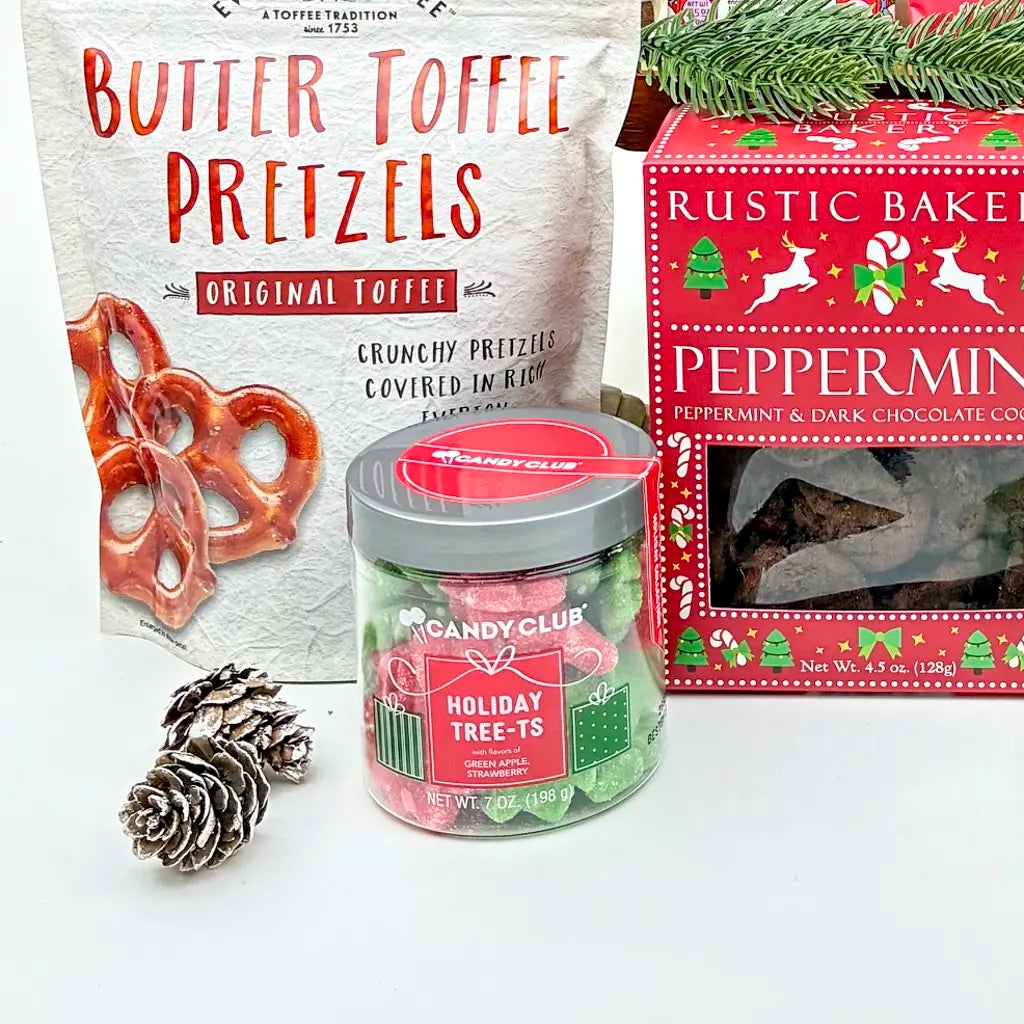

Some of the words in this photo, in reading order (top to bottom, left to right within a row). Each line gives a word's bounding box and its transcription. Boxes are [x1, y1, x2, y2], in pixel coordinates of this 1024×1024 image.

[263, 10, 269, 20] A
[274, 10, 321, 20] TOFFEE
[325, 10, 398, 20] TRADITION
[329, 23, 358, 33] 1753
[84, 47, 326, 138] BUTTER
[369, 49, 570, 145] TOFFEE
[167, 151, 482, 245] PRETZELS
[668, 190, 860, 222] RUSTIC
[206, 279, 336, 307] ORIGINAL
[356, 277, 447, 305] TOFFEE
[357, 340, 457, 365] CRUNCHY
[470, 330, 555, 360] PRETZELS
[365, 375, 461, 399] COVERED
[473, 373, 494, 393] IN
[505, 360, 546, 388] RICH
[674, 406, 783, 423] PEPPERMINT
[789, 408, 804, 423] &
[812, 408, 866, 423] DARK
[872, 408, 986, 423] CHOCOLATE
[426, 618, 512, 640] CANDY
[800, 660, 829, 673] Net
[833, 660, 860, 673] Wt.
[865, 660, 885, 673] 4.5
[890, 663, 909, 673] oz.
[914, 660, 957, 677] (128g)
[447, 690, 543, 716] HOLIDAY
[450, 718, 545, 742] TREE-TS
[464, 760, 496, 768] GREEN
[467, 767, 528, 778] STRAWBERRY
[427, 792, 452, 807] NET
[456, 792, 479, 810] WT.
[525, 790, 555, 808] (198
